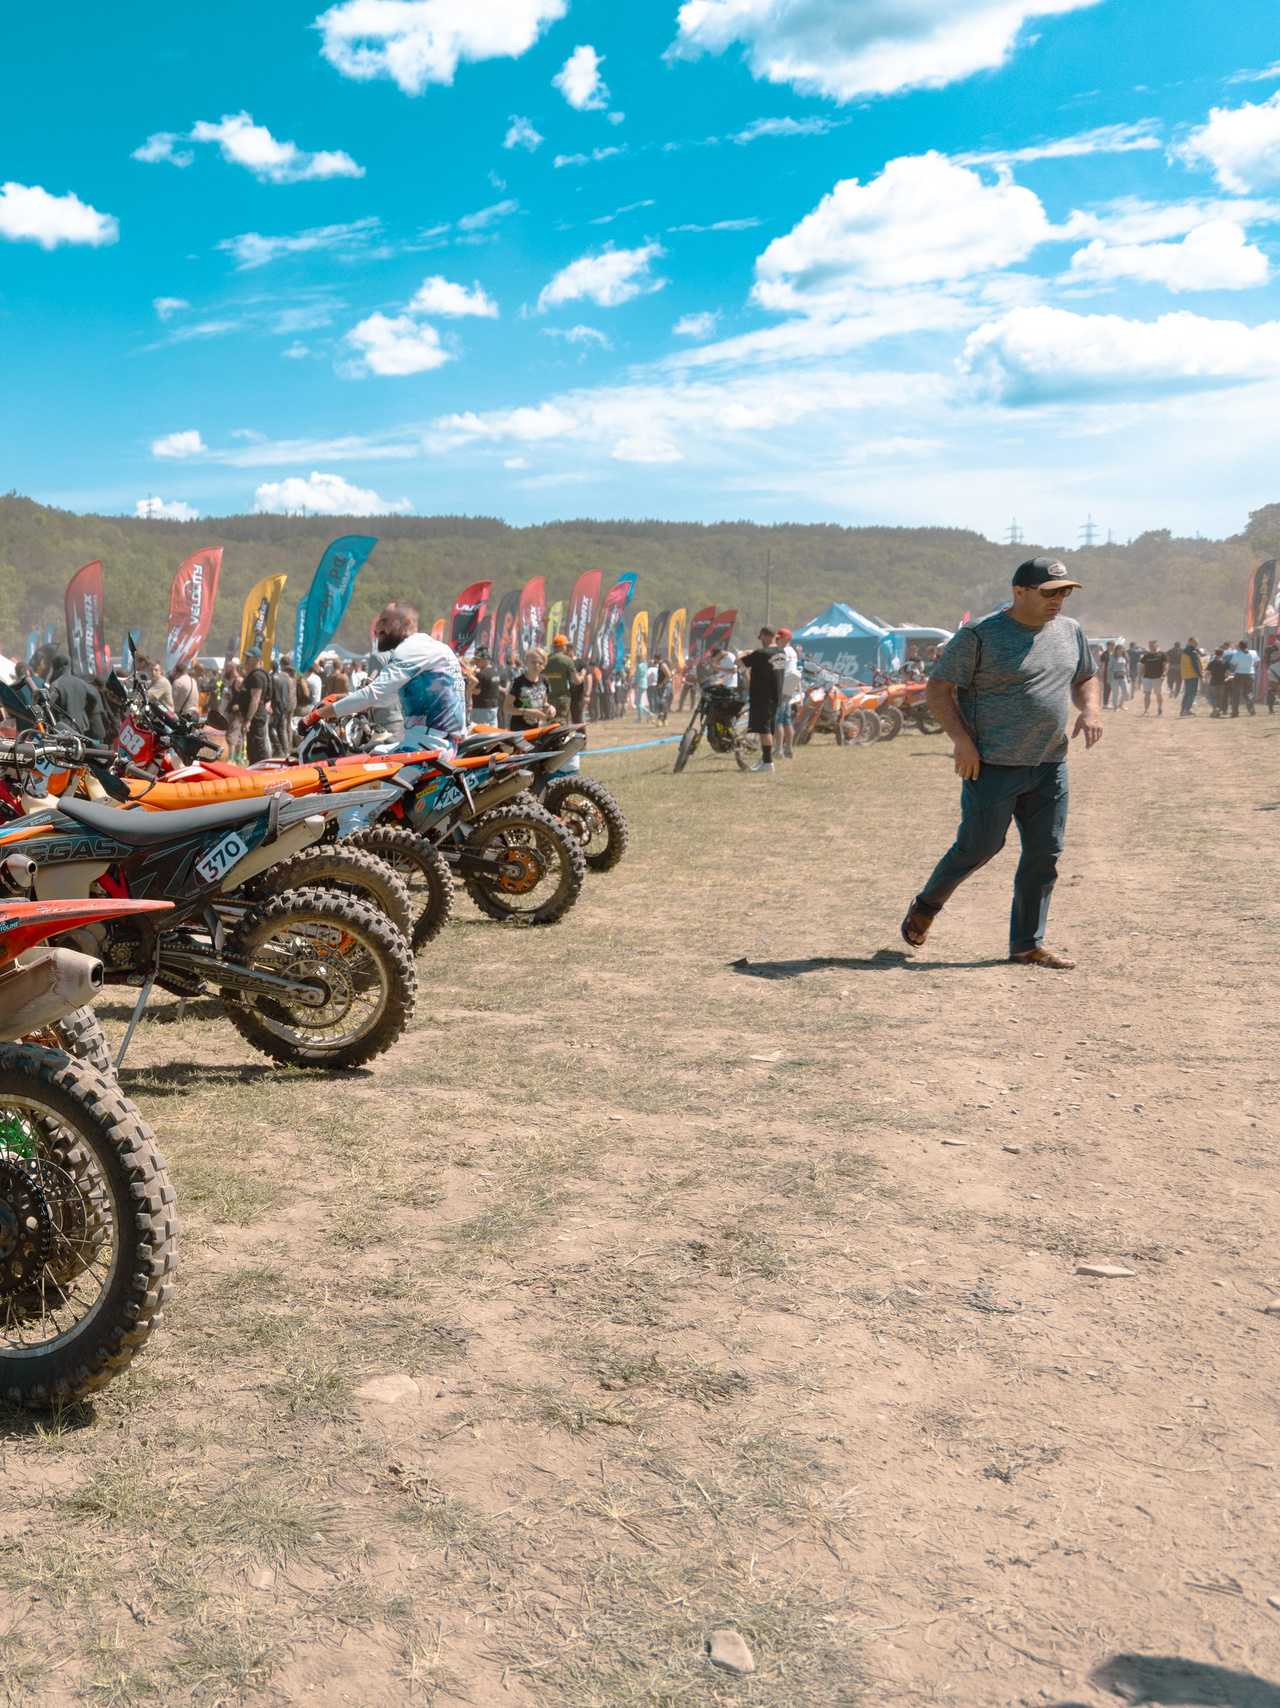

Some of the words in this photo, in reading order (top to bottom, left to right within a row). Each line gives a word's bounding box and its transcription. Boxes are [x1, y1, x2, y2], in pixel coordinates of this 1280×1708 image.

[189, 564, 203, 625] VELOCITY
[120, 725, 146, 755] 68
[30, 815, 51, 826] EC300
[1, 838, 119, 864] ASGAS
[202, 840, 240, 879] 370
